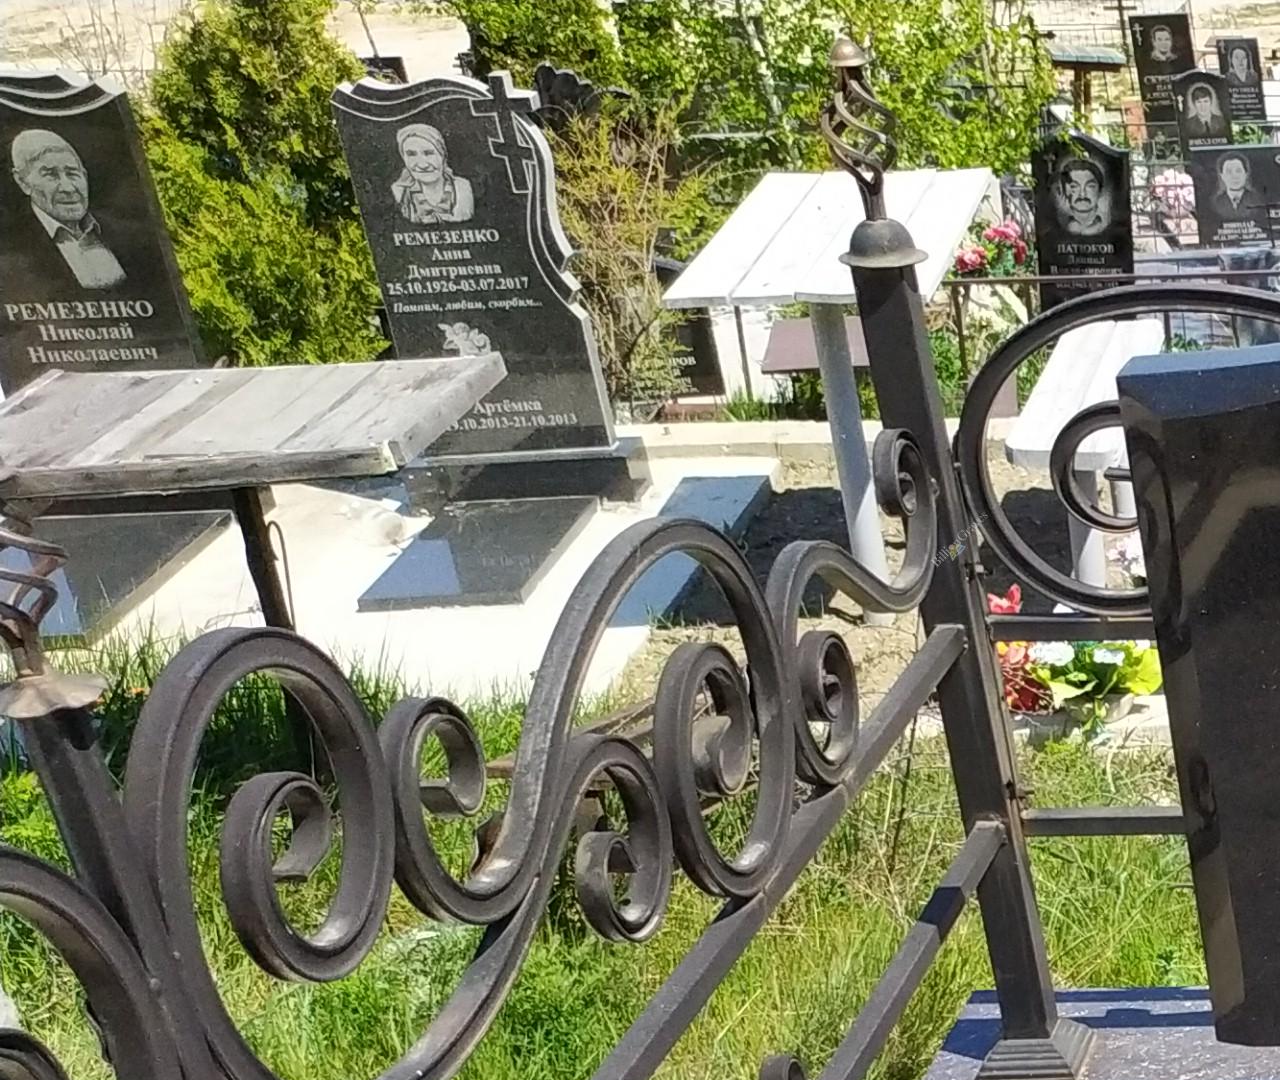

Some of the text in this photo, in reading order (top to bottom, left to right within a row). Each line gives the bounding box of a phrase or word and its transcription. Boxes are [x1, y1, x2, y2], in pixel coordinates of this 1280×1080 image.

[393, 229, 500, 247] РЕМЕЗЕНКО
[431, 248, 472, 262] Анна
[406, 264, 503, 280] Дмитриевна
[386, 276, 529, 296] 25.10.1926-03.07.2017
[5, 300, 154, 321] РЕМЕЗЕНКО
[393, 301, 444, 314] Помним,
[445, 300, 487, 311] любим,
[38, 322, 135, 343] Николай
[26, 346, 159, 364] Николаевич
